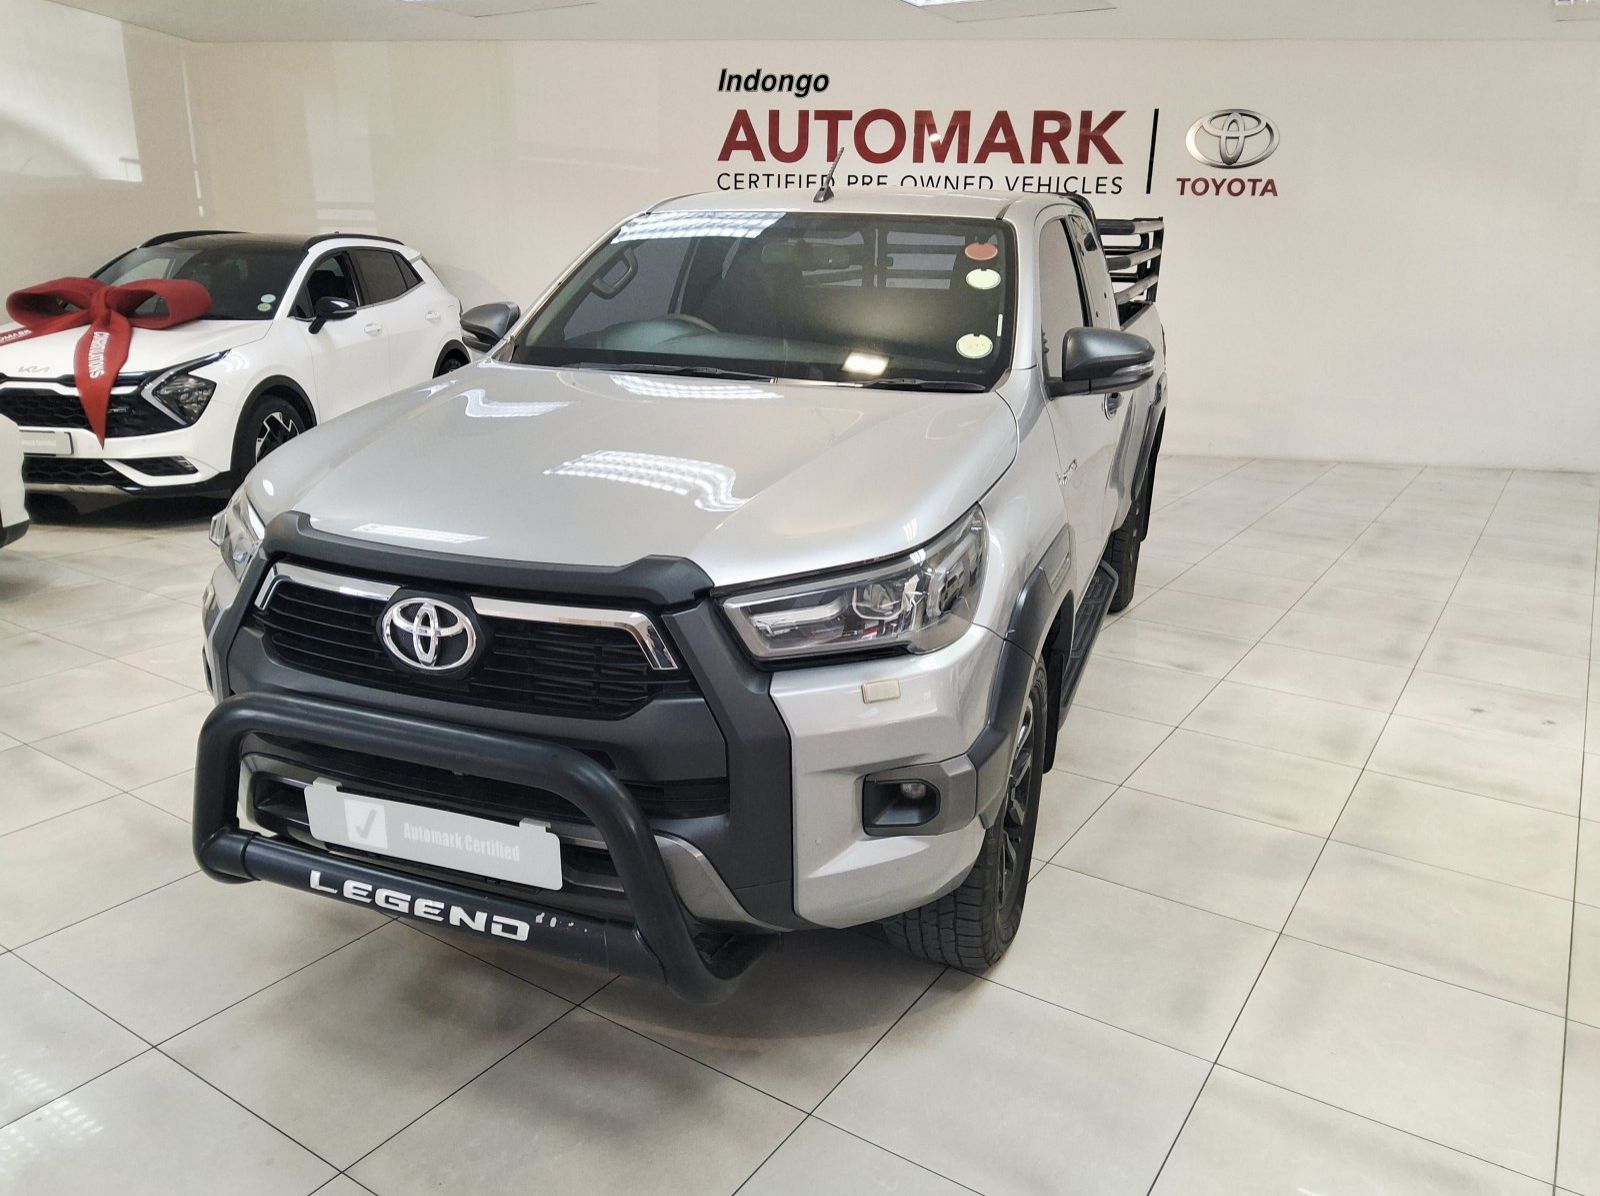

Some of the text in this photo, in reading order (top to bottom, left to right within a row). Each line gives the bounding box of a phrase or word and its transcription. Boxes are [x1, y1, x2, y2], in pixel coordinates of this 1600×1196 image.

[718, 68, 830, 98] Indongo
[717, 108, 1126, 164] AUTOMARK
[717, 172, 835, 190] CERTIFIED
[1005, 175, 1123, 194] VEHICLES
[1176, 177, 1278, 197] TOYOTA
[403, 822, 520, 862] Automark Certified
[309, 870, 530, 942] LEGEND
